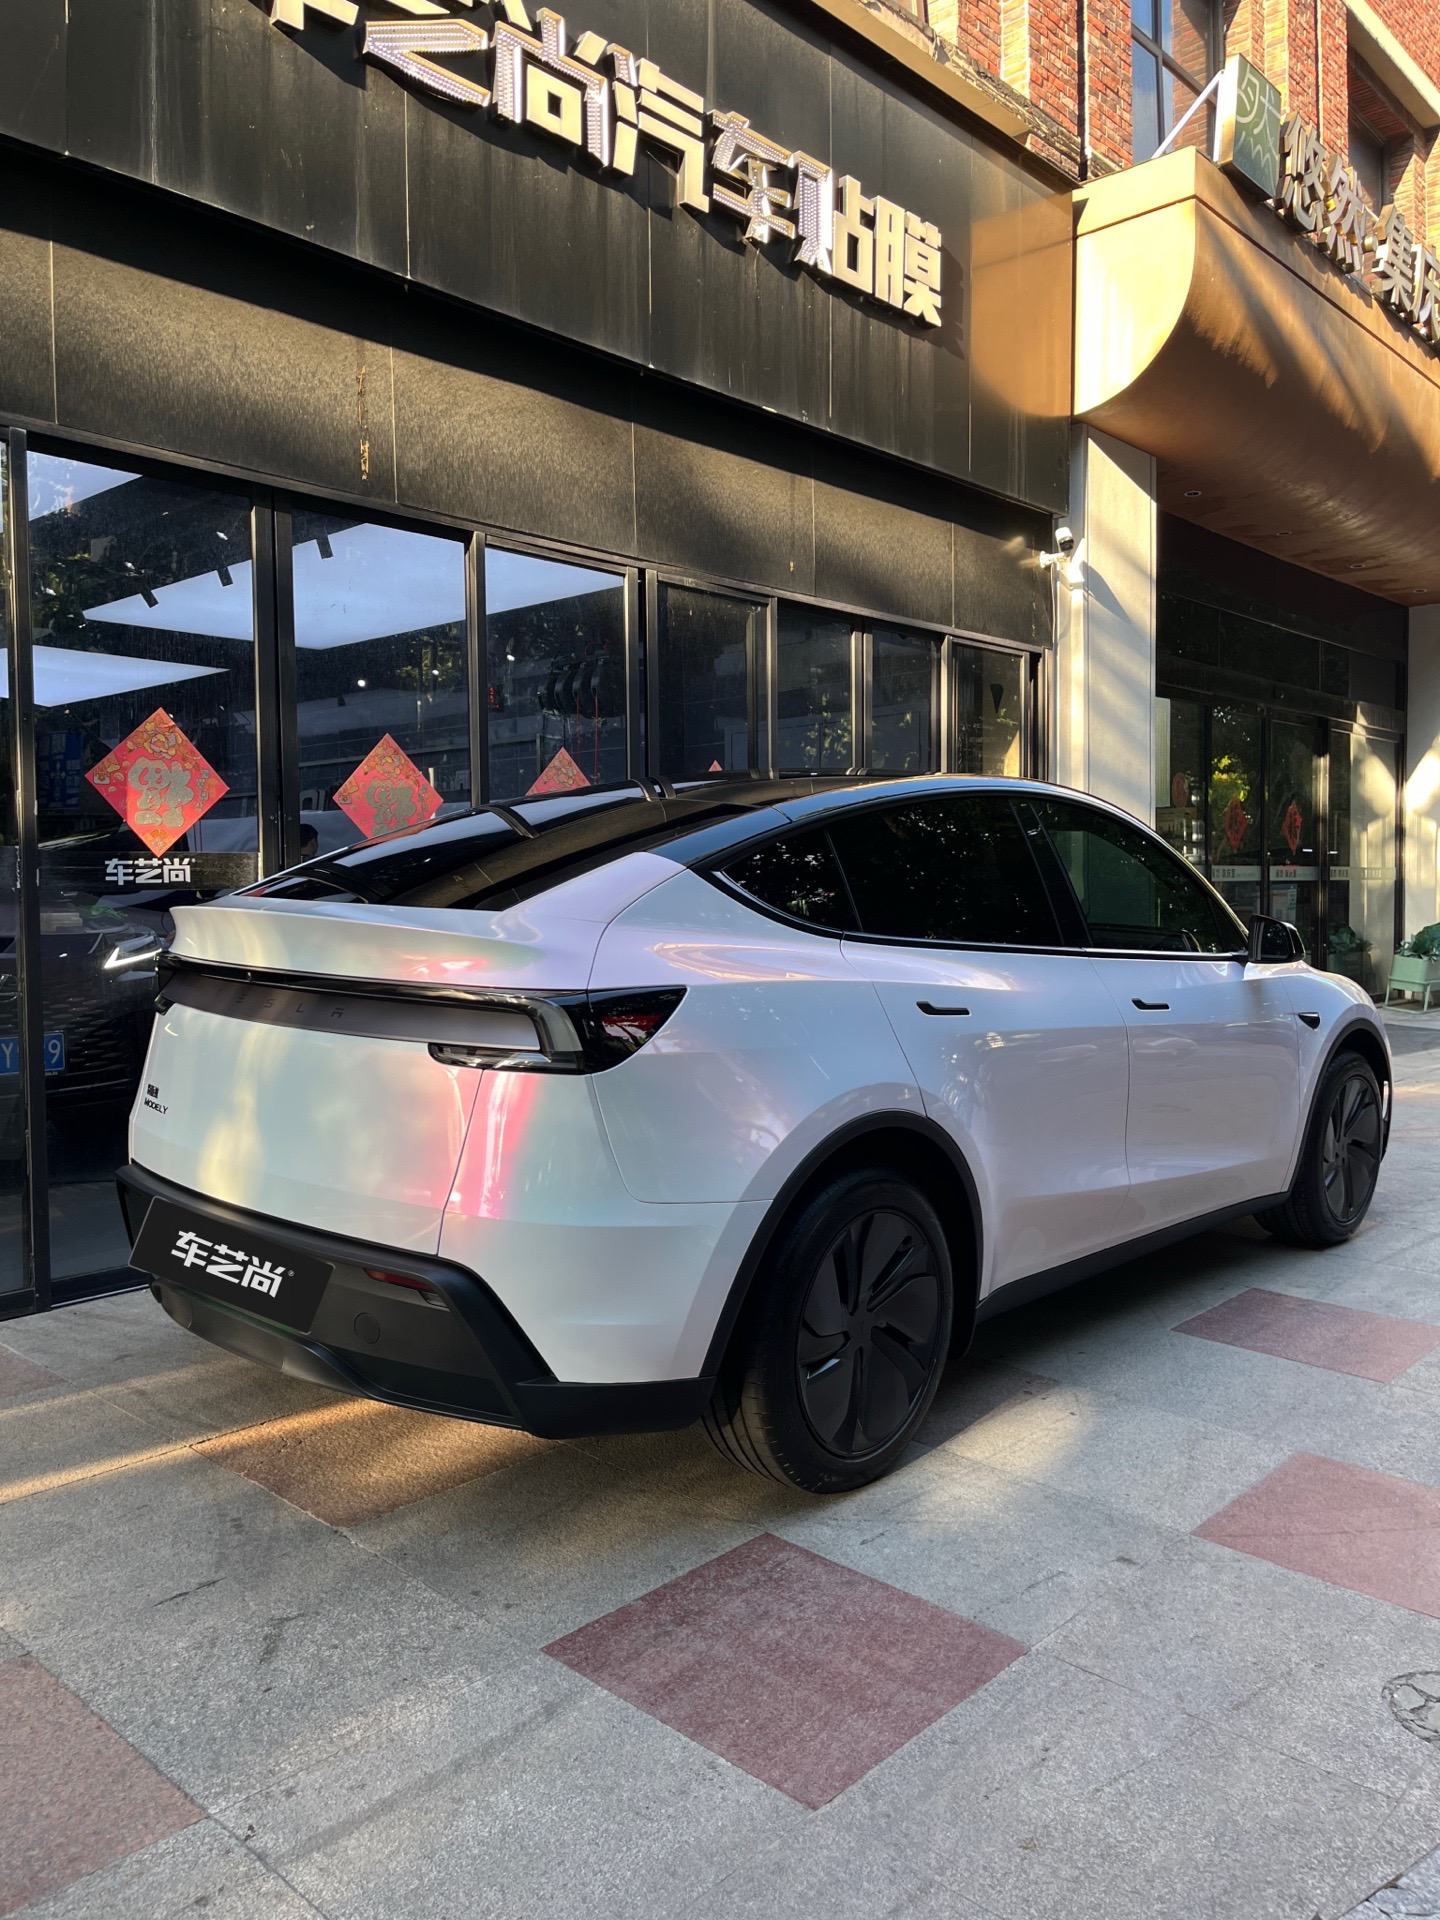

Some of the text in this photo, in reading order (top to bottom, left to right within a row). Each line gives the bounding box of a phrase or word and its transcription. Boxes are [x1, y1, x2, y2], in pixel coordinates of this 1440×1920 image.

[271, 0, 943, 328] 艺尚汽车贴膜
[104, 857, 191, 886] 车艺尚
